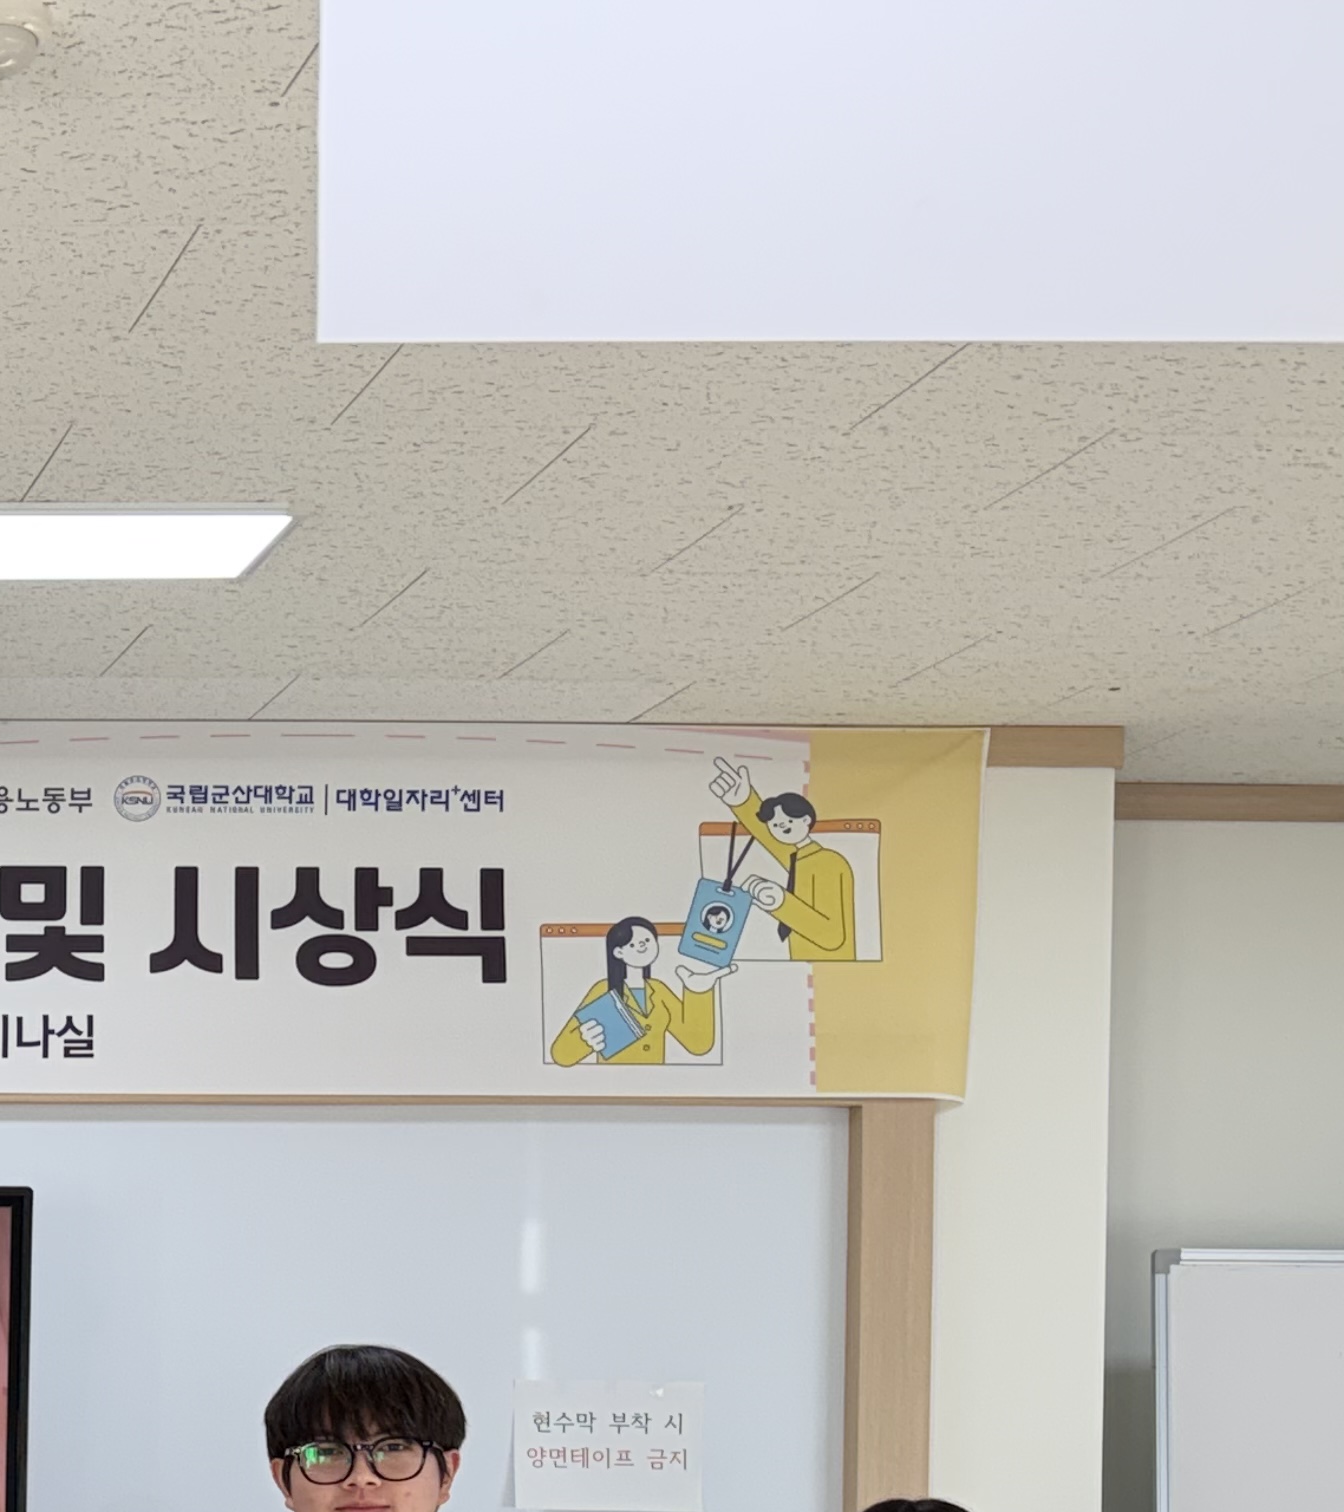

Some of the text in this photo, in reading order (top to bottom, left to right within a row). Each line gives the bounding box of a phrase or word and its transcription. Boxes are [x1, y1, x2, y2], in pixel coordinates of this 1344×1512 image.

[166, 784, 315, 804] 국립군산대학교
[148, 865, 507, 987] 시상식
[532, 1411, 684, 1435] 현수막 부착 시
[526, 1446, 688, 1471] 양면테이프 금지
